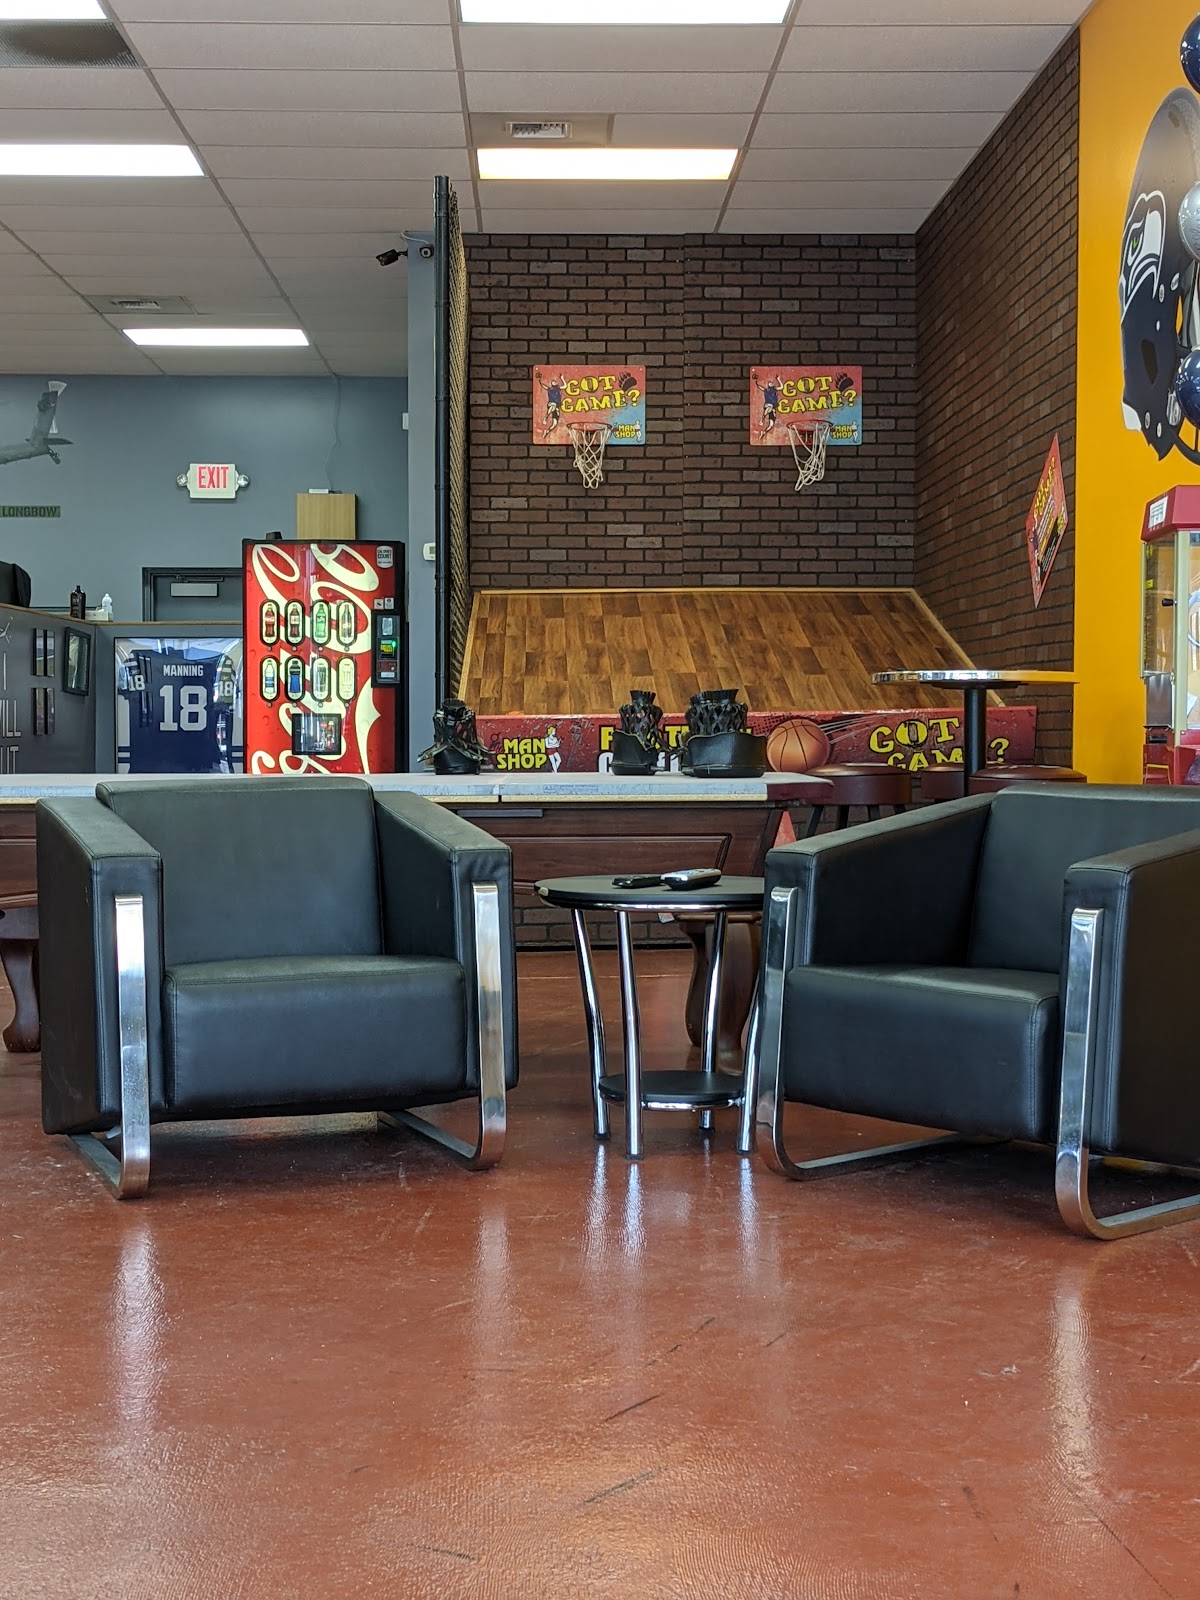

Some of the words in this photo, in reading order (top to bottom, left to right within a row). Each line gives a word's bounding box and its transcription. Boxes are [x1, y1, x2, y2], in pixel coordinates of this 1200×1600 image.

[565, 375, 616, 396] GOT
[782, 376, 833, 397] GOT
[560, 389, 641, 412] GAME?
[777, 389, 857, 414] GAME?
[832, 431, 852, 439] SHOP
[198, 466, 229, 489] EXIT
[2, 505, 57, 518] LONGBOW
[162, 664, 204, 677] MANNING
[128, 674, 145, 692] 18
[217, 680, 233, 697] 18
[0, 699, 22, 738] ILL
[159, 684, 208, 732] 18
[869, 717, 960, 753] GOT
[503, 738, 546, 755] MAN
[887, 738, 1010, 772] GAM?
[496, 753, 548, 771] SHOP
